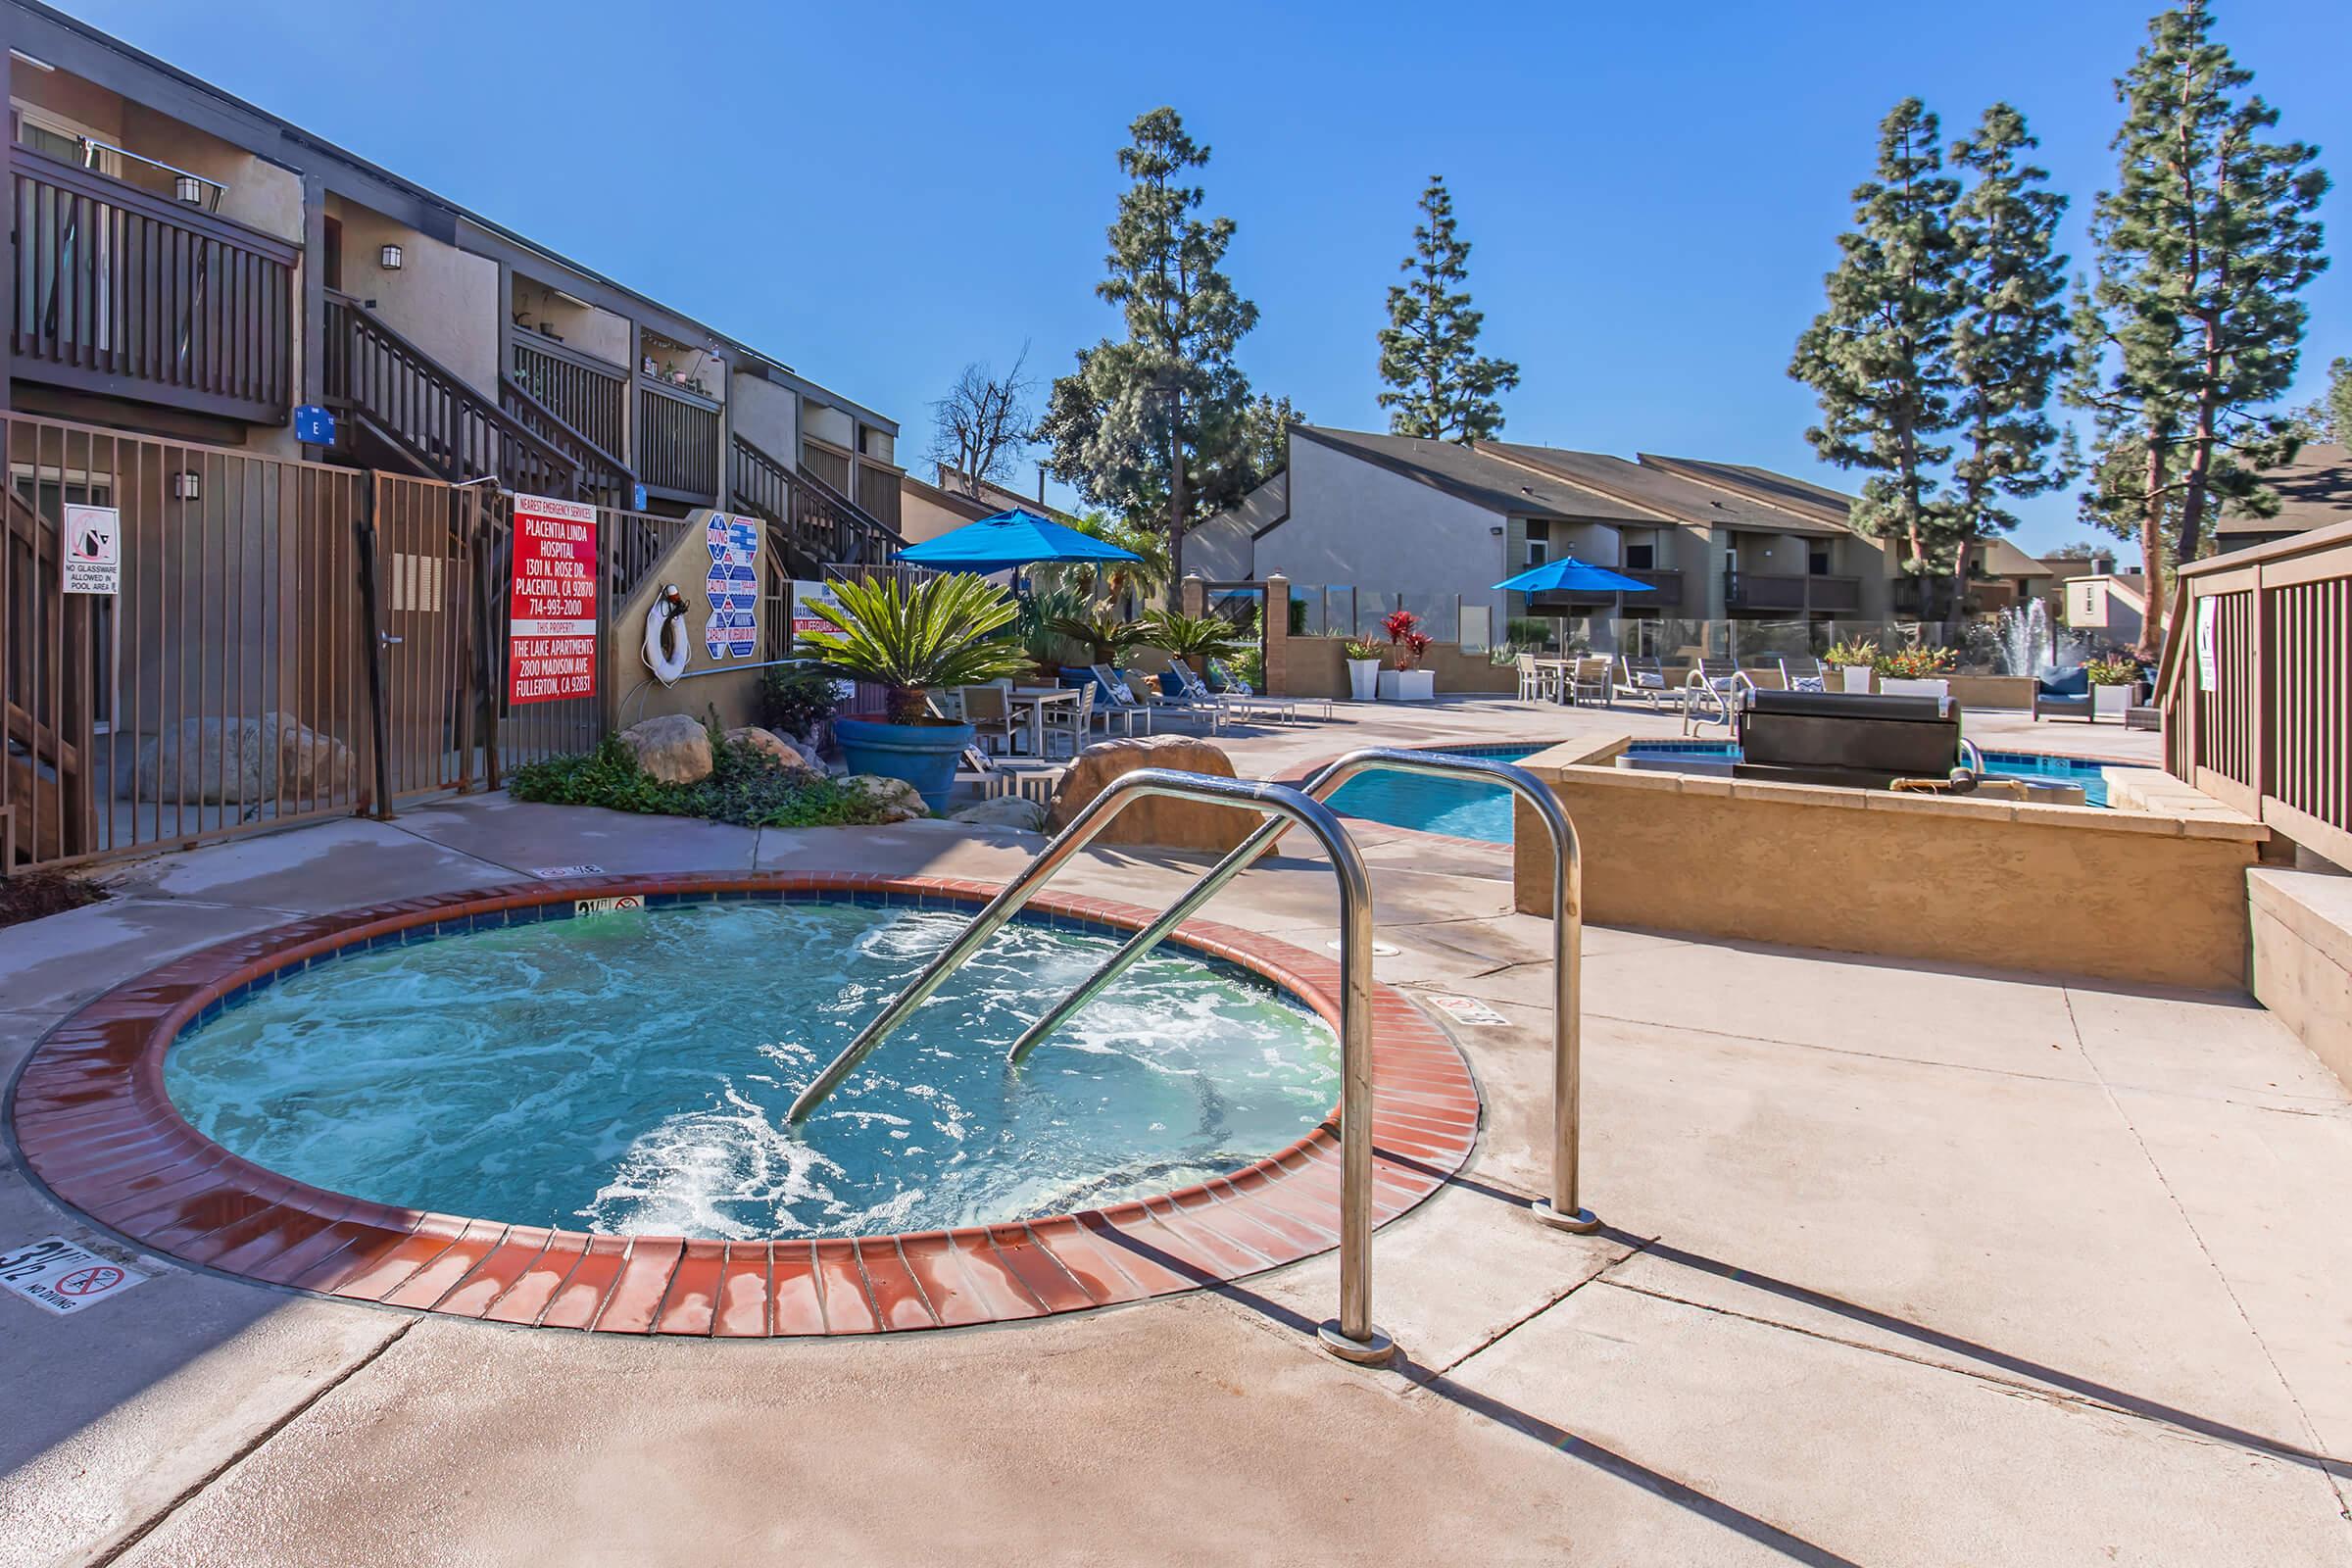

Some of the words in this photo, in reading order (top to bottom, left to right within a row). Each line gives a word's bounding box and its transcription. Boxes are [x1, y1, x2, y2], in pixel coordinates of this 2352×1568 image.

[313, 422, 319, 435] E
[520, 498, 542, 511] NEAREST
[543, 502, 570, 516] EMERGENCY
[526, 519, 565, 539] PLACENTIA
[567, 525, 588, 541] LINDA
[714, 515, 723, 529] NO
[708, 529, 727, 544] DIVING
[540, 541, 574, 558] HOSPITAL
[78, 565, 117, 574] GLASSWARE
[526, 559, 542, 575] 1301
[544, 561, 553, 577] N.
[554, 561, 573, 578] ROSE
[574, 563, 586, 578] DR.
[516, 578, 560, 598] PLACENTIA,
[562, 581, 571, 596] CA
[573, 581, 593, 597] 92870
[529, 598, 582, 616] 714-993-2000
[537, 622, 548, 634] THIS
[796, 620, 803, 631] NO
[514, 641, 529, 657] THE
[531, 640, 549, 657] LAKE
[551, 639, 593, 656] APARTMENTS
[520, 661, 540, 678] 2800
[542, 659, 573, 676] MADISON
[575, 658, 588, 673] AVE
[516, 678, 560, 697] FULLERTON,
[561, 677, 570, 693] CA
[572, 676, 590, 692] 92831
[24, 1283, 47, 1294] NO
[39, 1290, 77, 1309] DIVING
